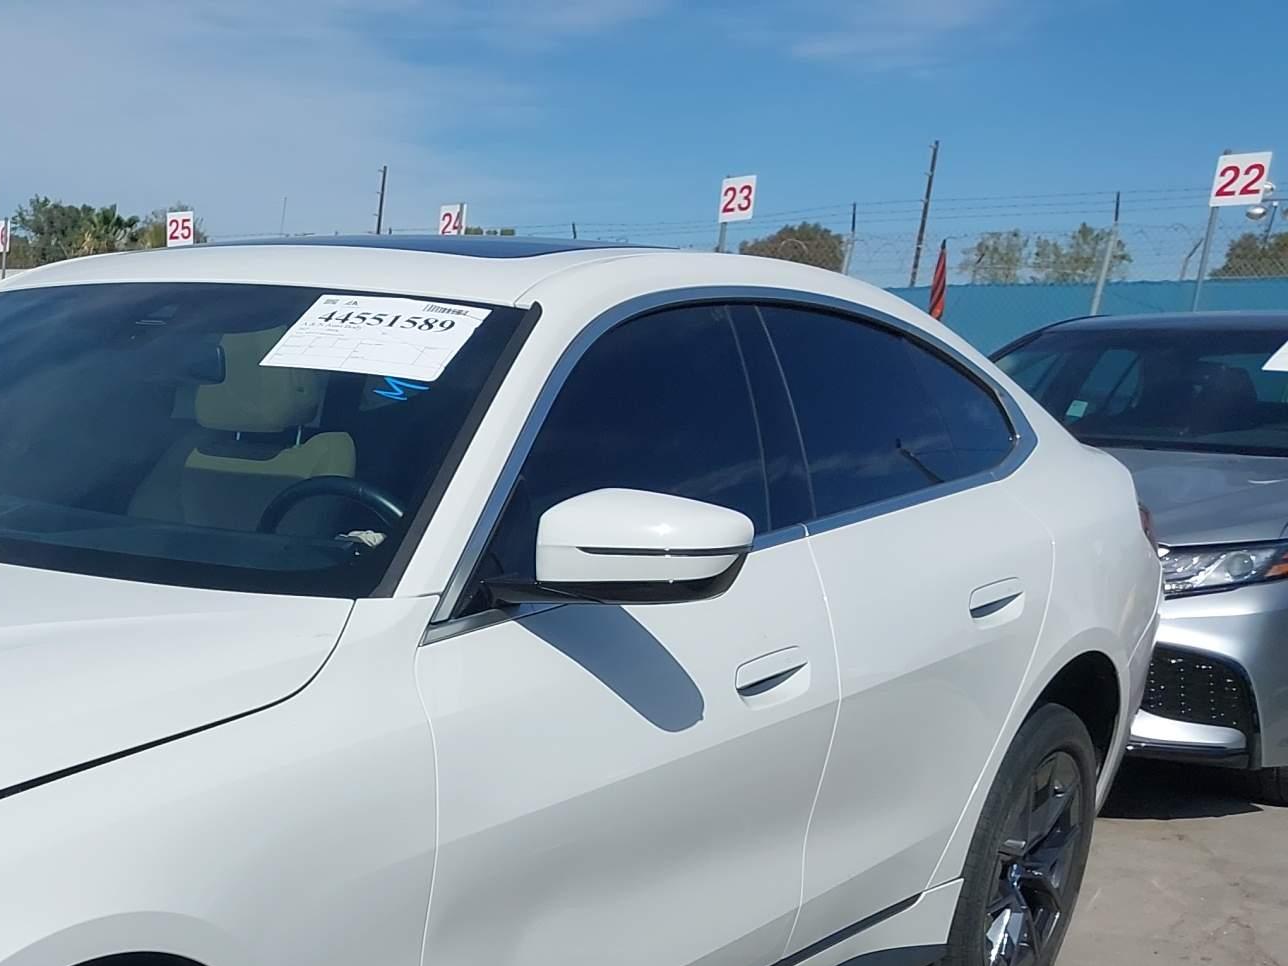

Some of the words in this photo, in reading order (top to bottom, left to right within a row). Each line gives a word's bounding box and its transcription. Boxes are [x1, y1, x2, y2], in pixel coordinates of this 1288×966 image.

[1215, 164, 1265, 197] 22
[722, 185, 752, 213] 23
[169, 219, 191, 240] 25
[318, 310, 456, 333] 44551589
